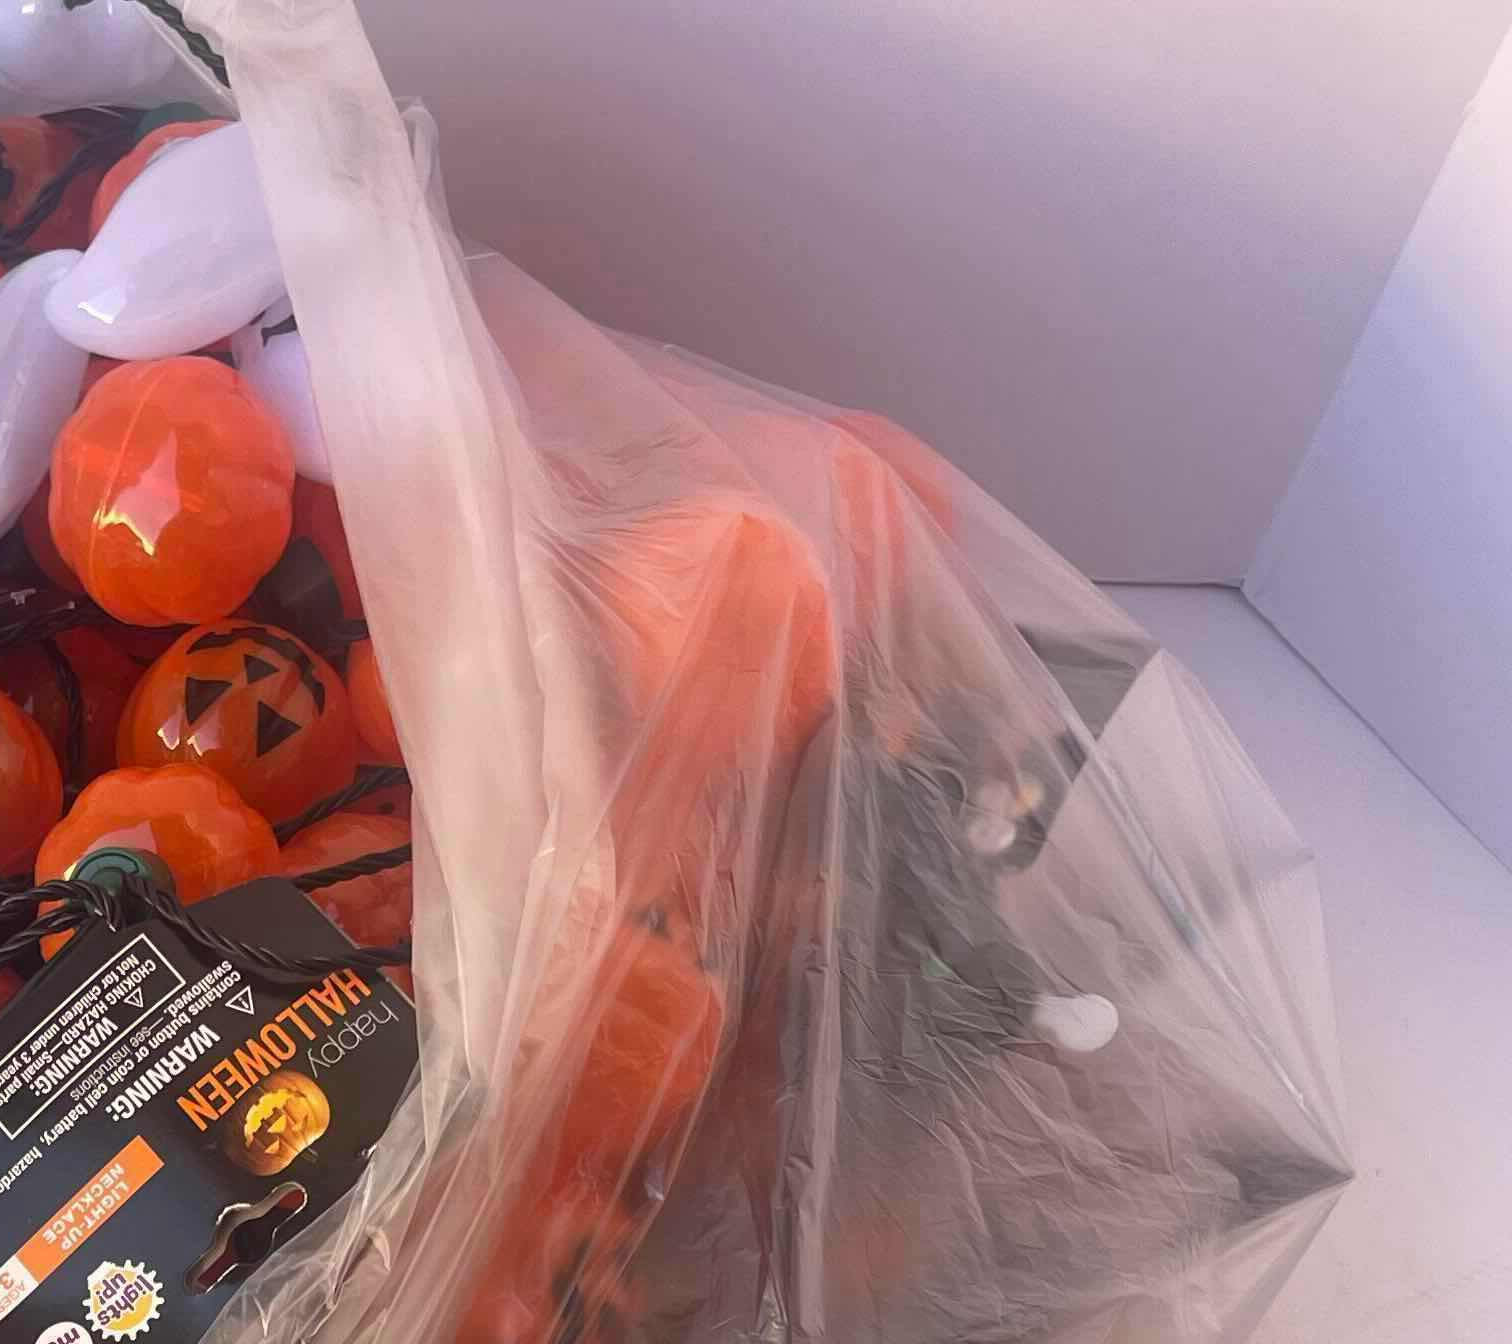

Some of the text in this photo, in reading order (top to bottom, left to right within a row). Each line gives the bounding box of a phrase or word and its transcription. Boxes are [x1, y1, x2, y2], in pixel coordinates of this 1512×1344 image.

[29, 953, 140, 1056] Not children under
[104, 959, 157, 1005] CHOKING
[187, 970, 241, 1016] contains
[29, 1017, 118, 1096] WARNING:
[69, 960, 234, 1101] swallowed. instructions
[148, 1012, 192, 1049] button
[179, 971, 369, 1129] HALLOWEEN
[307, 1001, 399, 1078] happy
[82, 1080, 111, 1111] cell
[105, 1057, 138, 1089] coin
[106, 1024, 220, 1121] WARNING:
[39, 1102, 89, 1146] battery,
[42, 1164, 124, 1243] NECKLACE
[54, 1181, 130, 1250] LIGHT-UP
[91, 1270, 131, 1307] up!
[95, 1273, 154, 1326] lights
